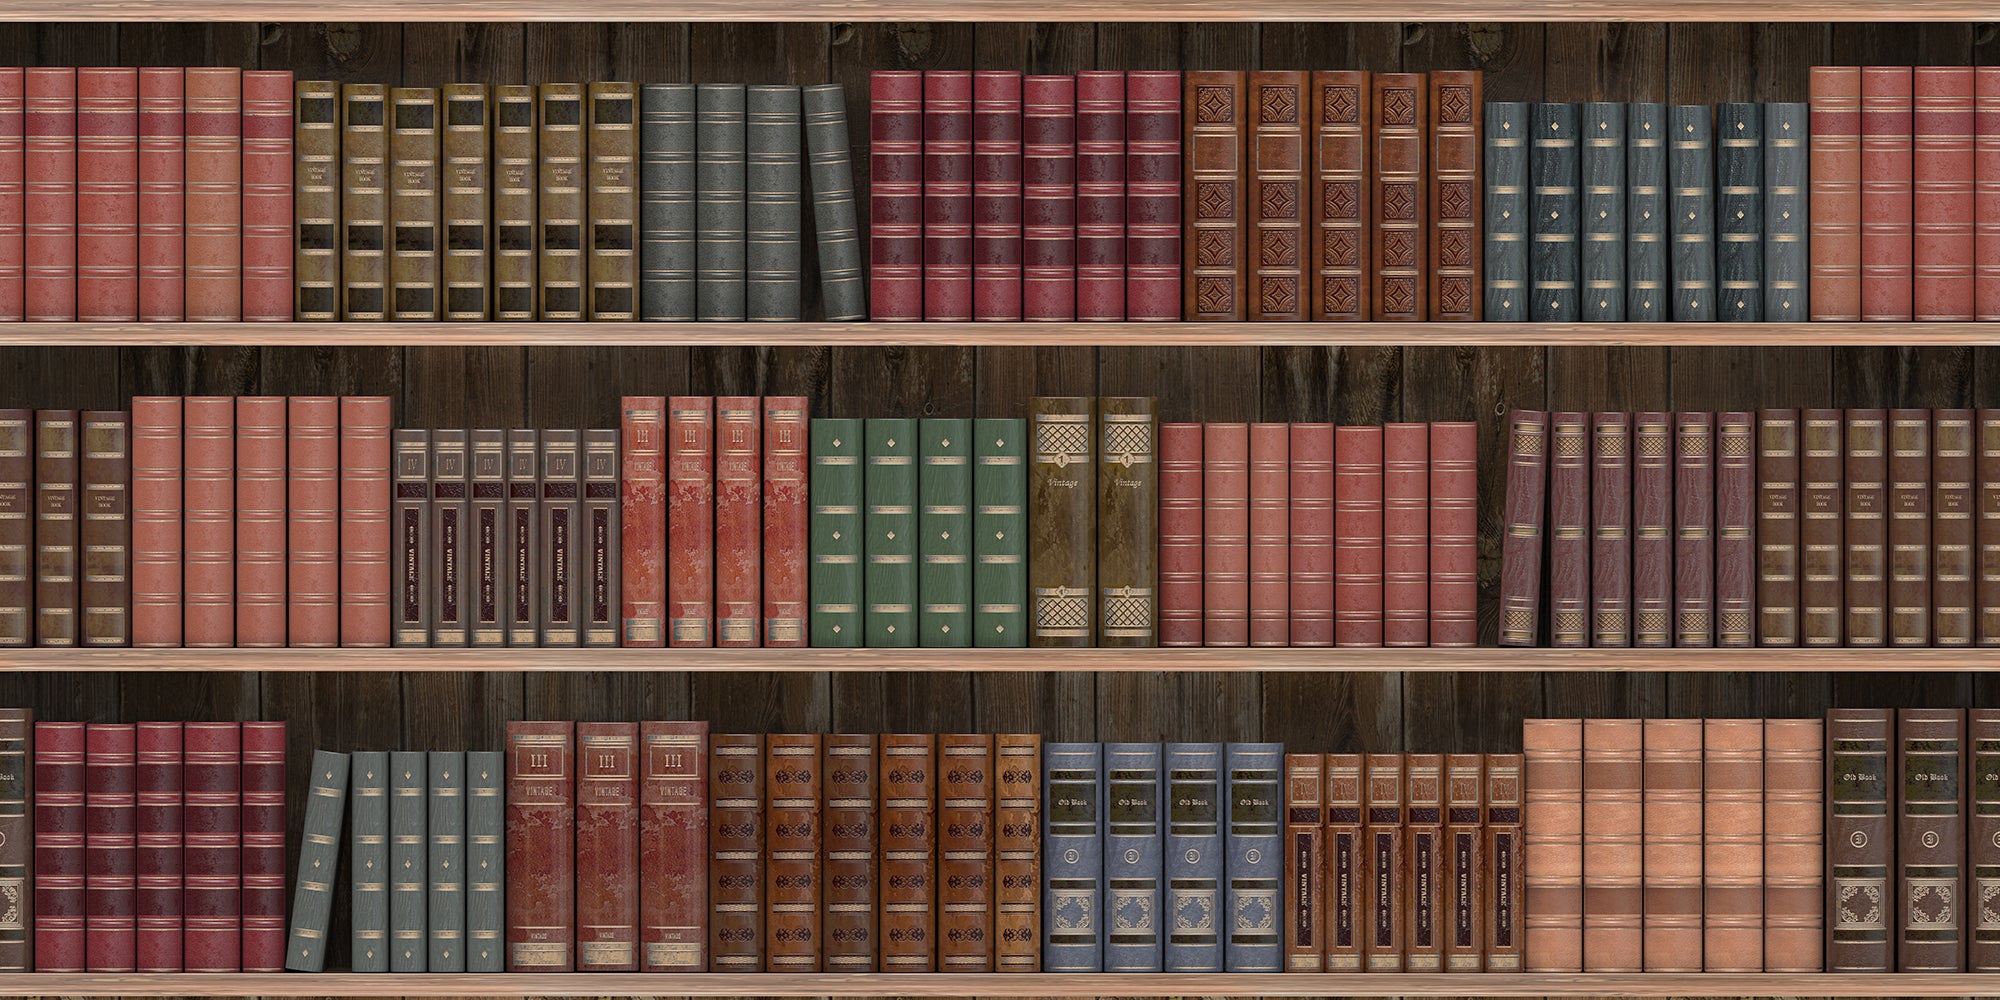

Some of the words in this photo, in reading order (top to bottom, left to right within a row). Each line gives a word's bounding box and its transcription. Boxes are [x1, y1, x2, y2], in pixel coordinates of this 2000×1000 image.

[637, 430, 648, 442] III
[684, 430, 696, 442] III
[732, 430, 743, 442] III
[780, 430, 791, 442] III
[408, 458, 418, 470] IV
[446, 458, 456, 470] IV
[484, 458, 494, 470] IV
[519, 458, 528, 470] IV
[556, 458, 566, 470] IV
[596, 458, 606, 470] IV
[1047, 479, 1078, 488] Vintage
[1114, 479, 1142, 488] Vintage
[531, 754, 548, 767] III
[599, 755, 615, 768] III
[664, 754, 682, 767] III
[1843, 773, 1856, 781] Old
[1858, 773, 1877, 781] Book
[1915, 773, 1928, 781] Old
[1930, 773, 1948, 781] Book
[1986, 773, 1998, 781] Old
[526, 786, 553, 796] VINTAGE
[595, 787, 620, 797] VINTAGE
[660, 786, 687, 796] VINTAGE
